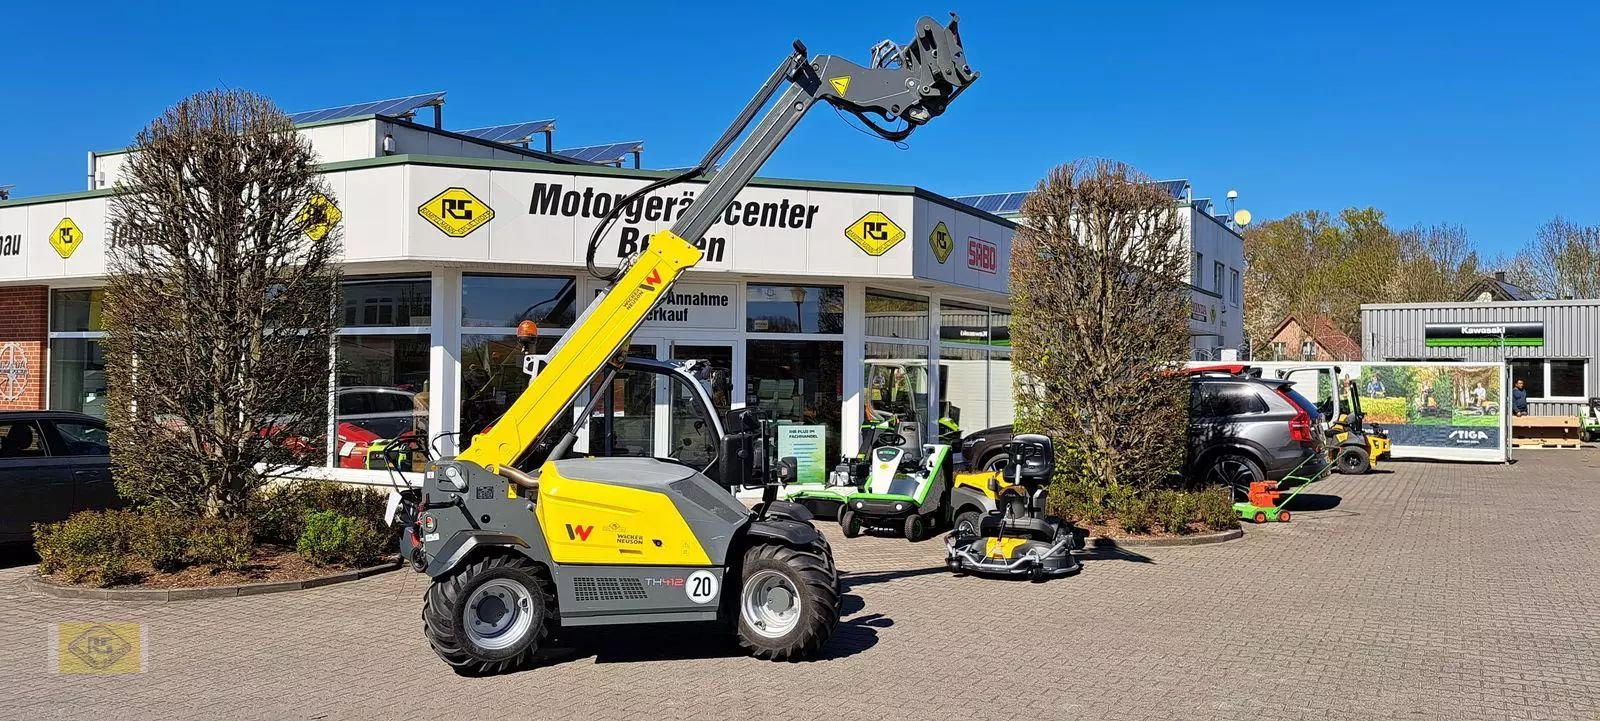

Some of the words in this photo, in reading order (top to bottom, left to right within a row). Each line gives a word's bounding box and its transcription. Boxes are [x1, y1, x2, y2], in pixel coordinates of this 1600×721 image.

[442, 198, 472, 220] RS
[864, 222, 887, 240] RS
[0, 234, 21, 256] au
[969, 241, 996, 270] SABO
[646, 307, 688, 321] erkauf
[1461, 326, 1506, 334] Kawasaki
[1448, 430, 1488, 439] STIGA
[645, 578, 684, 586] TH412
[693, 577, 711, 596] 20
